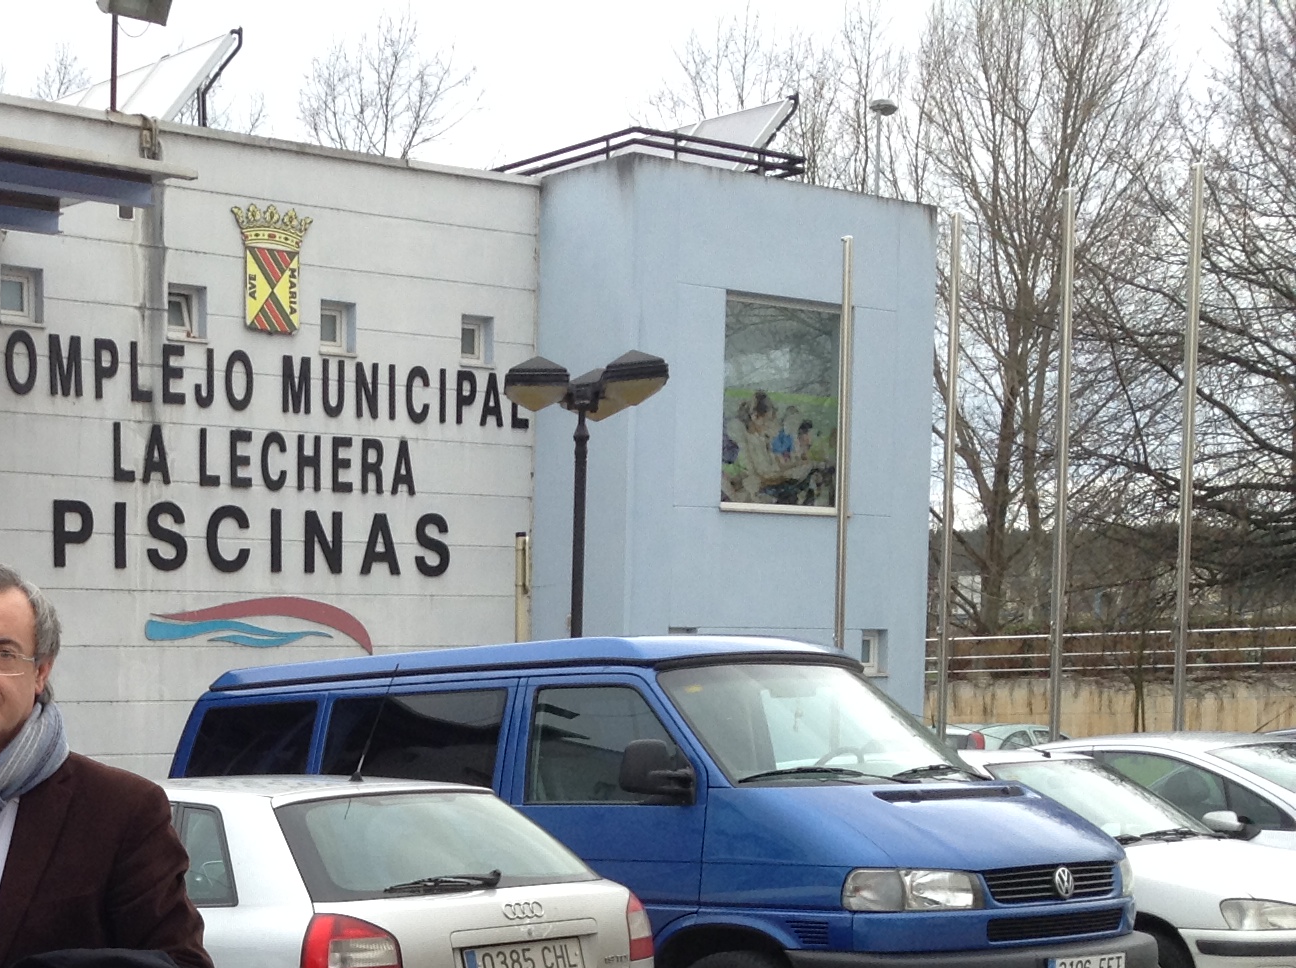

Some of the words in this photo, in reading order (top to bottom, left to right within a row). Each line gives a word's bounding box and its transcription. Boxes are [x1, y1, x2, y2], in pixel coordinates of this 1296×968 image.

[248, 273, 257, 301] AVE
[288, 267, 297, 315] MARIA
[282, 354, 529, 431] MUNICIPAL
[112, 421, 172, 485] LA
[199, 427, 417, 497] LECHERA
[52, 498, 452, 578] PISCINAS
